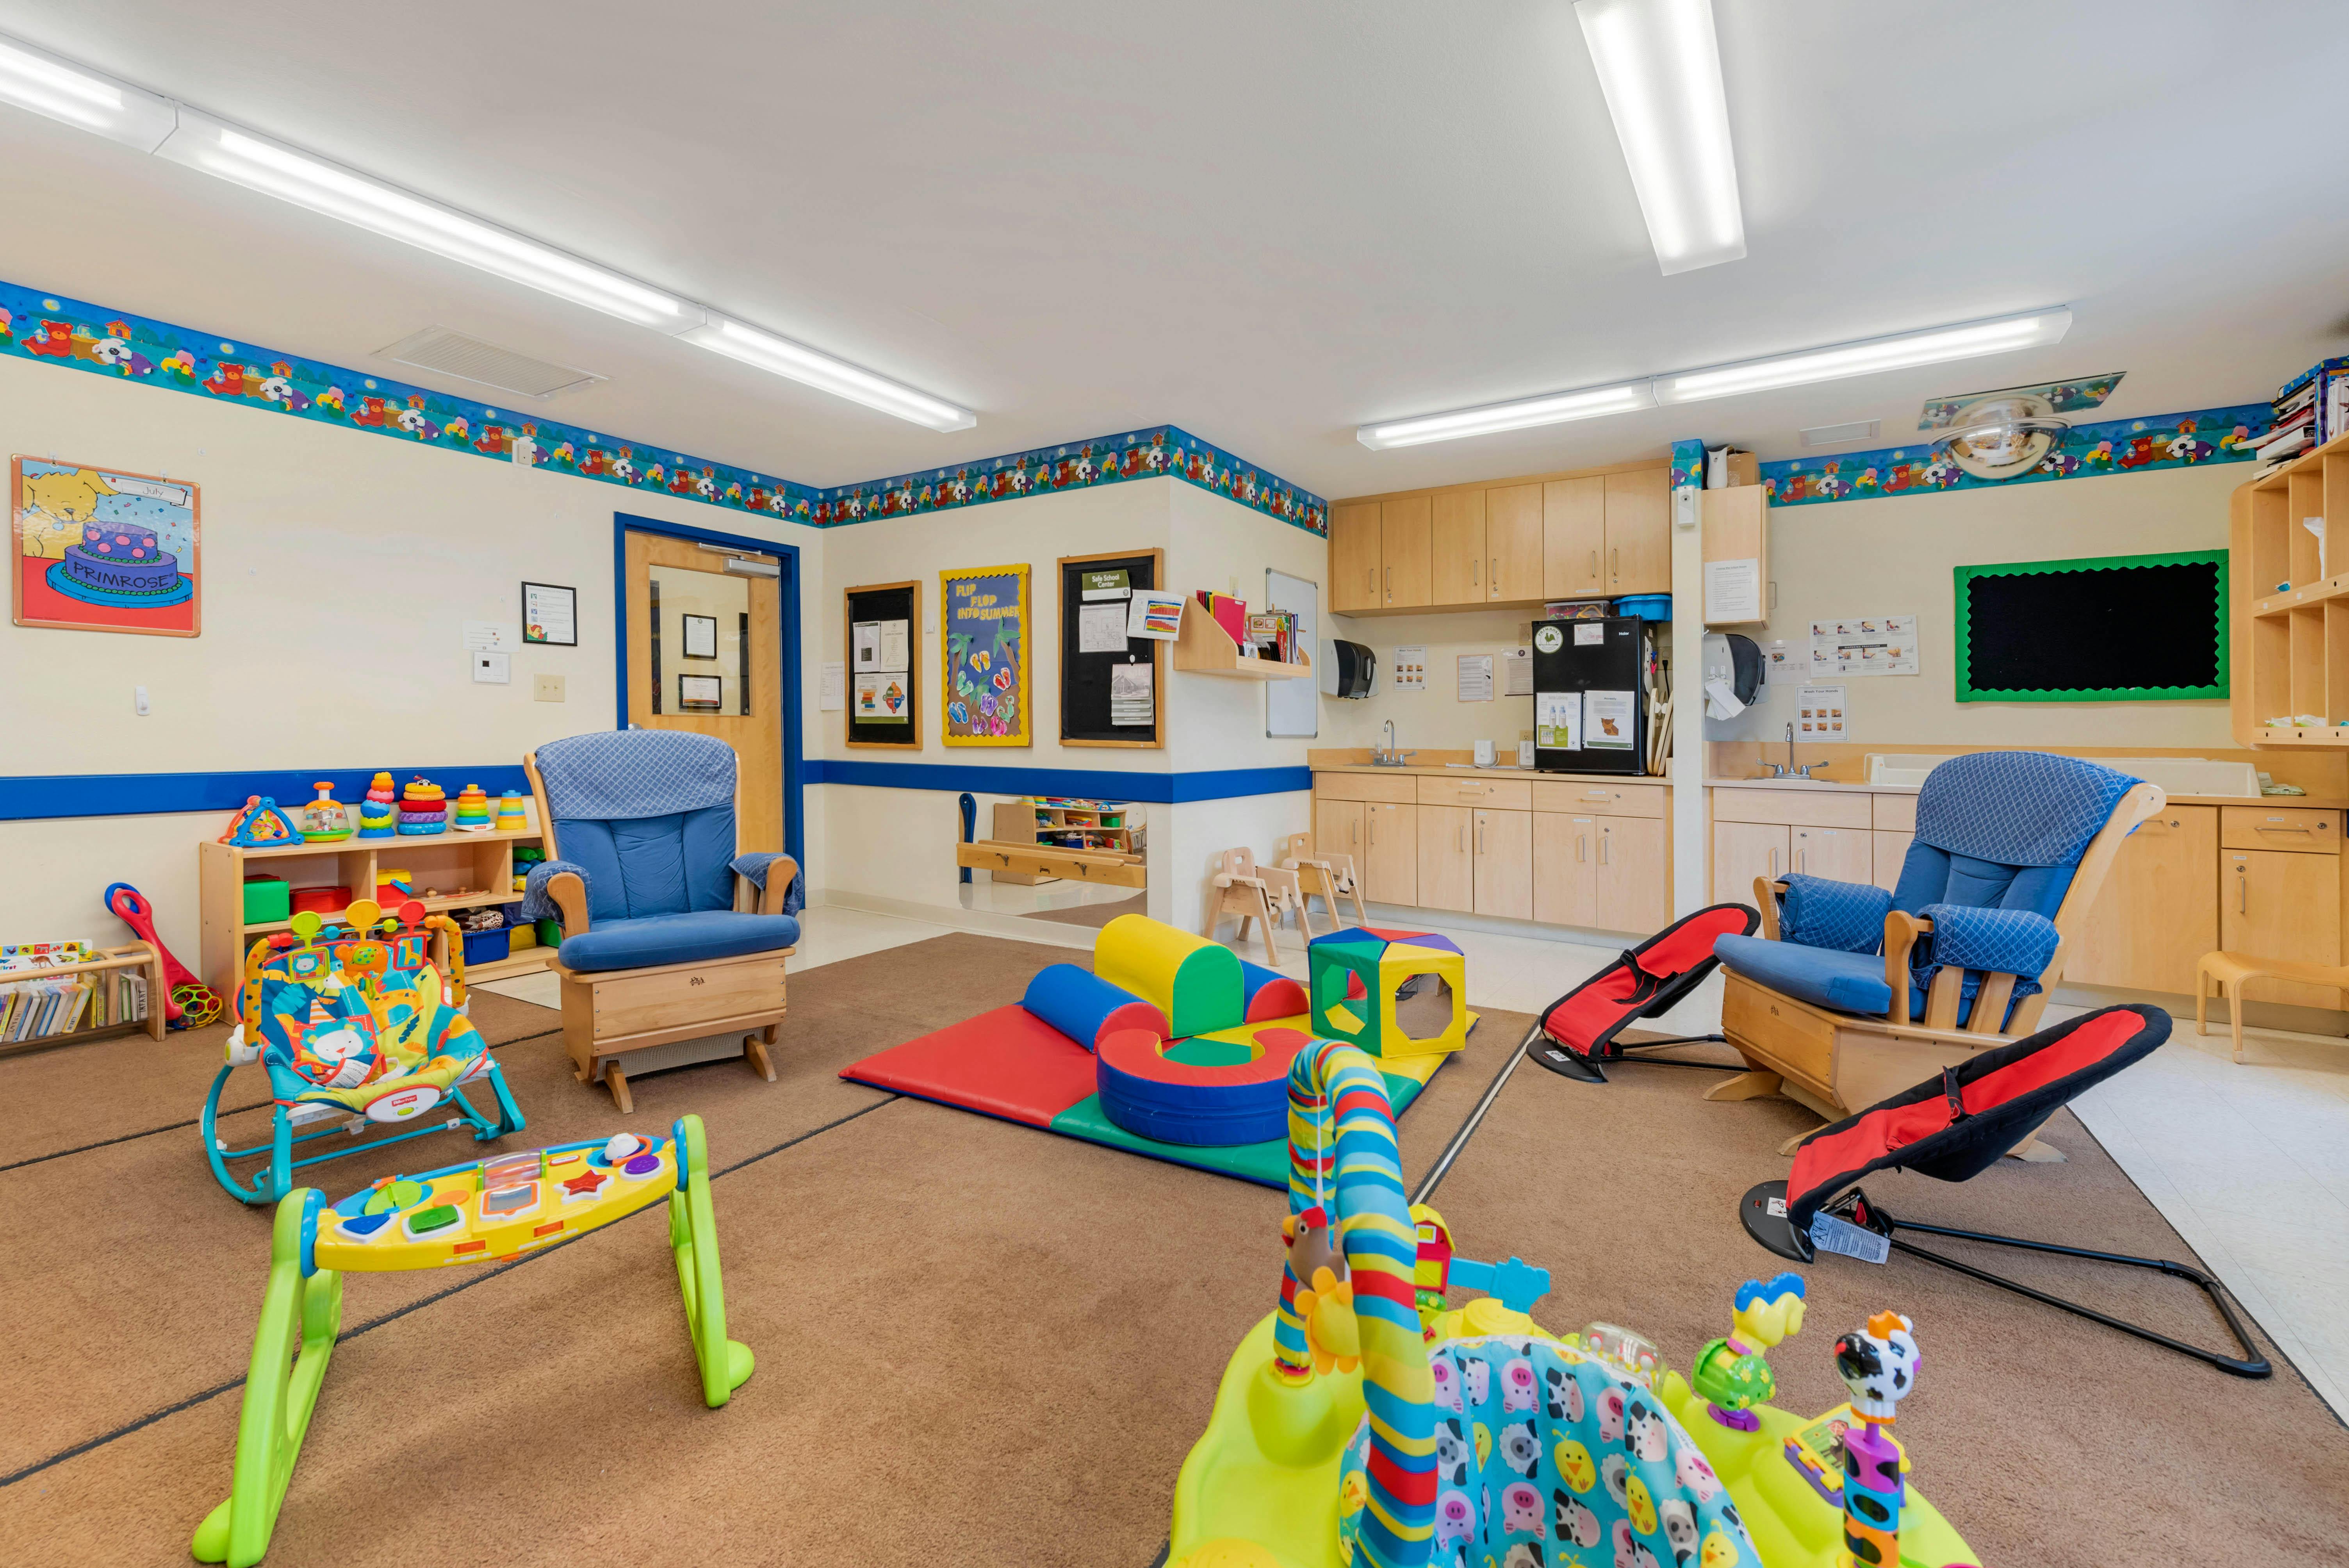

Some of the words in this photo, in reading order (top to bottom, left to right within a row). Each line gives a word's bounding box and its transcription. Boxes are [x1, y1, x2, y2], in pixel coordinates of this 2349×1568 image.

[143, 487, 164, 497] July
[956, 584, 976, 597] FLIP
[971, 595, 997, 607] FLOP
[958, 607, 979, 619] INTO
[980, 606, 1020, 620] SUMMER
[1538, 628, 1560, 637] PRIMROSE
